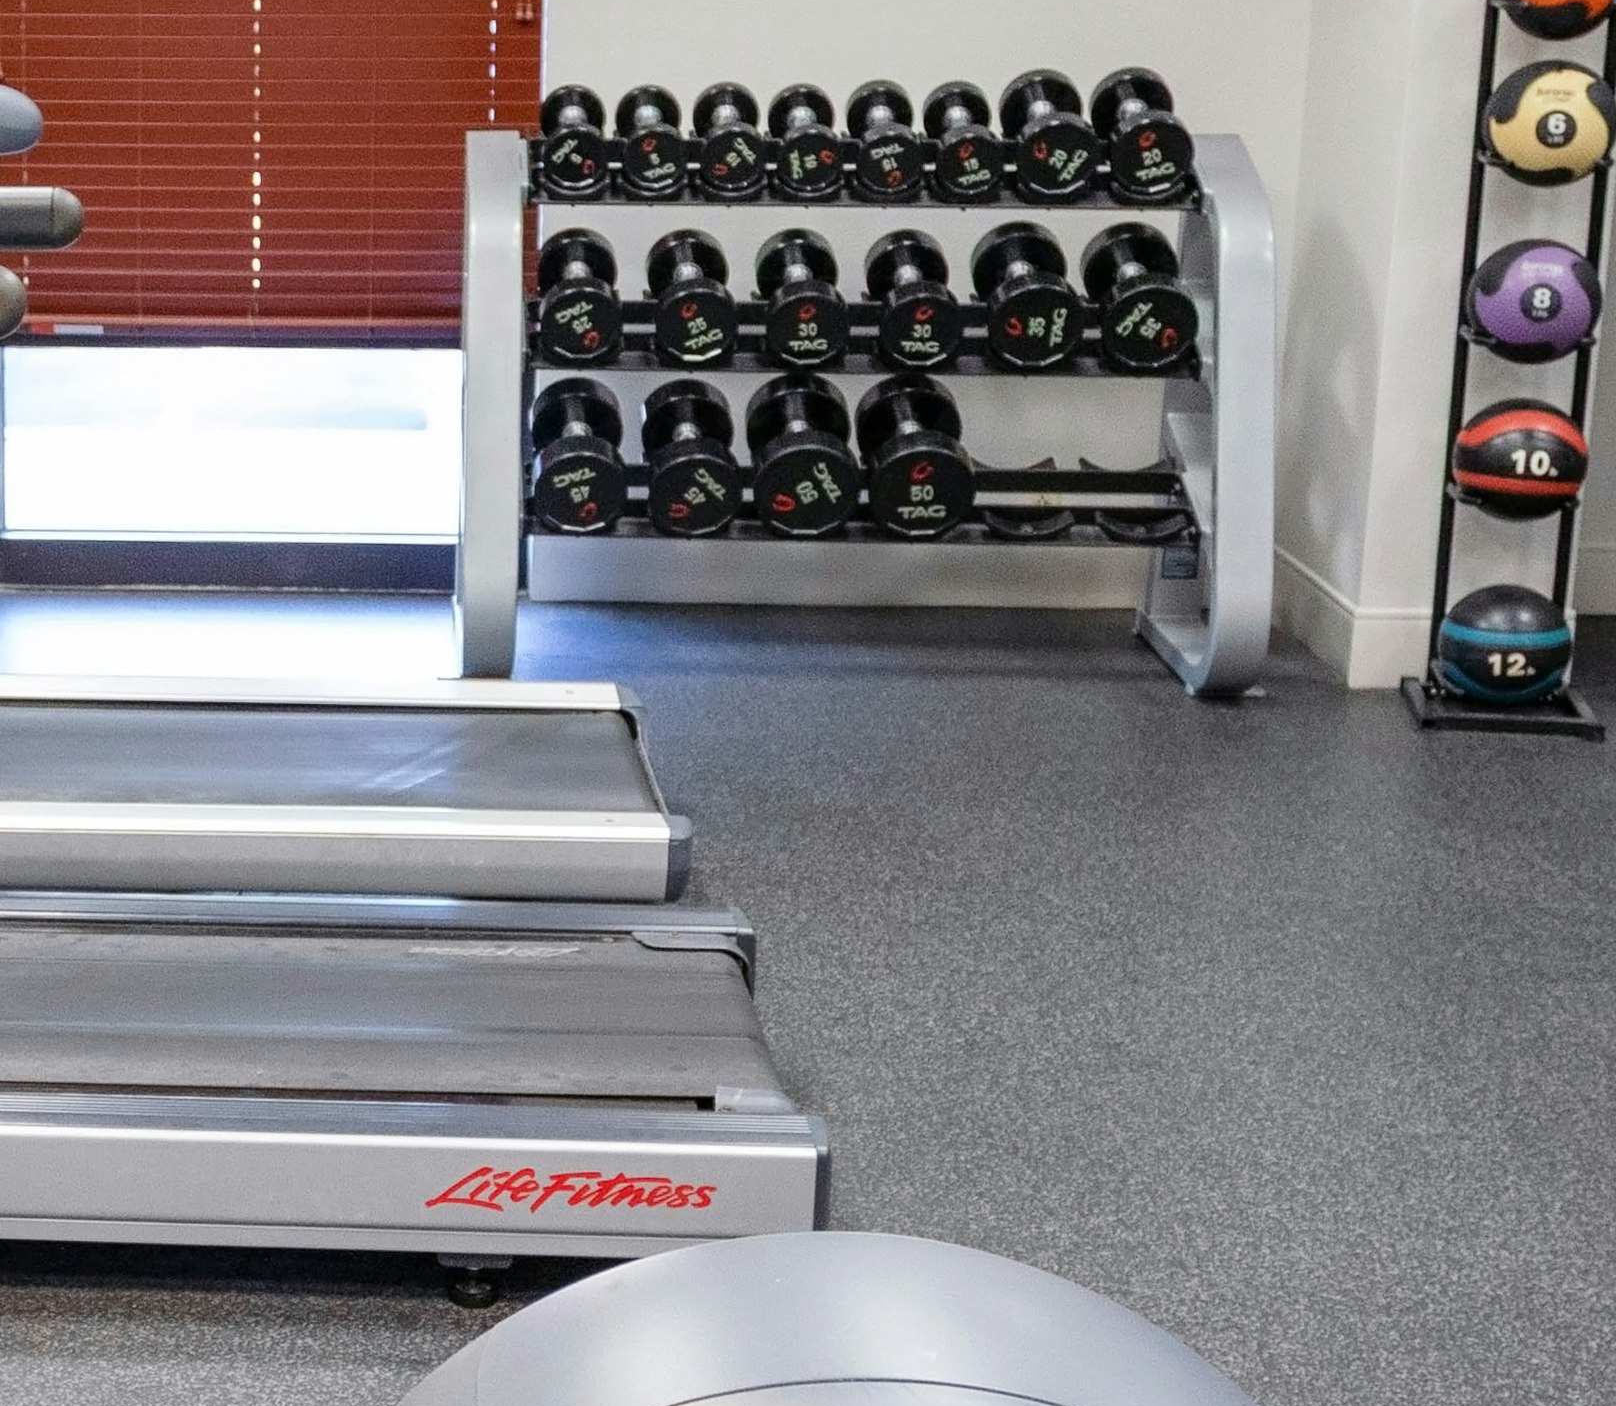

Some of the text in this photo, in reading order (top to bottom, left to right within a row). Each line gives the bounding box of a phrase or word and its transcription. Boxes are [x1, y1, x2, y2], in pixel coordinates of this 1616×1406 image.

[1548, 113, 1566, 135] 6
[551, 139, 579, 164] TAG
[734, 137, 757, 165] TAG
[870, 143, 904, 160] TAG
[1048, 148, 1068, 168] 20
[1140, 149, 1163, 166] 20
[642, 162, 676, 179] TAG
[788, 149, 803, 181] TAG
[881, 157, 898, 172] 15
[962, 158, 980, 171] 15
[1059, 148, 1089, 182] TAG
[1134, 162, 1176, 182] TAG
[958, 168, 992, 186] TAG
[1533, 287, 1552, 309] 8
[555, 300, 593, 325] TAG
[1116, 301, 1153, 337] TAG
[571, 315, 593, 334] 25
[686, 317, 707, 335] 25
[797, 322, 818, 337] 30
[911, 324, 932, 339] 30
[1027, 316, 1046, 338] 35
[1049, 307, 1068, 347] TAG
[1139, 317, 1162, 340] 35
[684, 328, 724, 351] TAG
[789, 339, 829, 351] TAG
[900, 340, 940, 354] TAG
[1511, 448, 1550, 476] 10
[552, 467, 597, 488] TAG
[694, 467, 727, 502] TAG
[813, 461, 844, 504] TAG
[570, 484, 590, 504] 45
[683, 486, 707, 506] 45
[795, 481, 819, 506] 50
[909, 484, 935, 503] 50
[897, 504, 947, 519] TAG
[1488, 652, 1526, 676] 12
